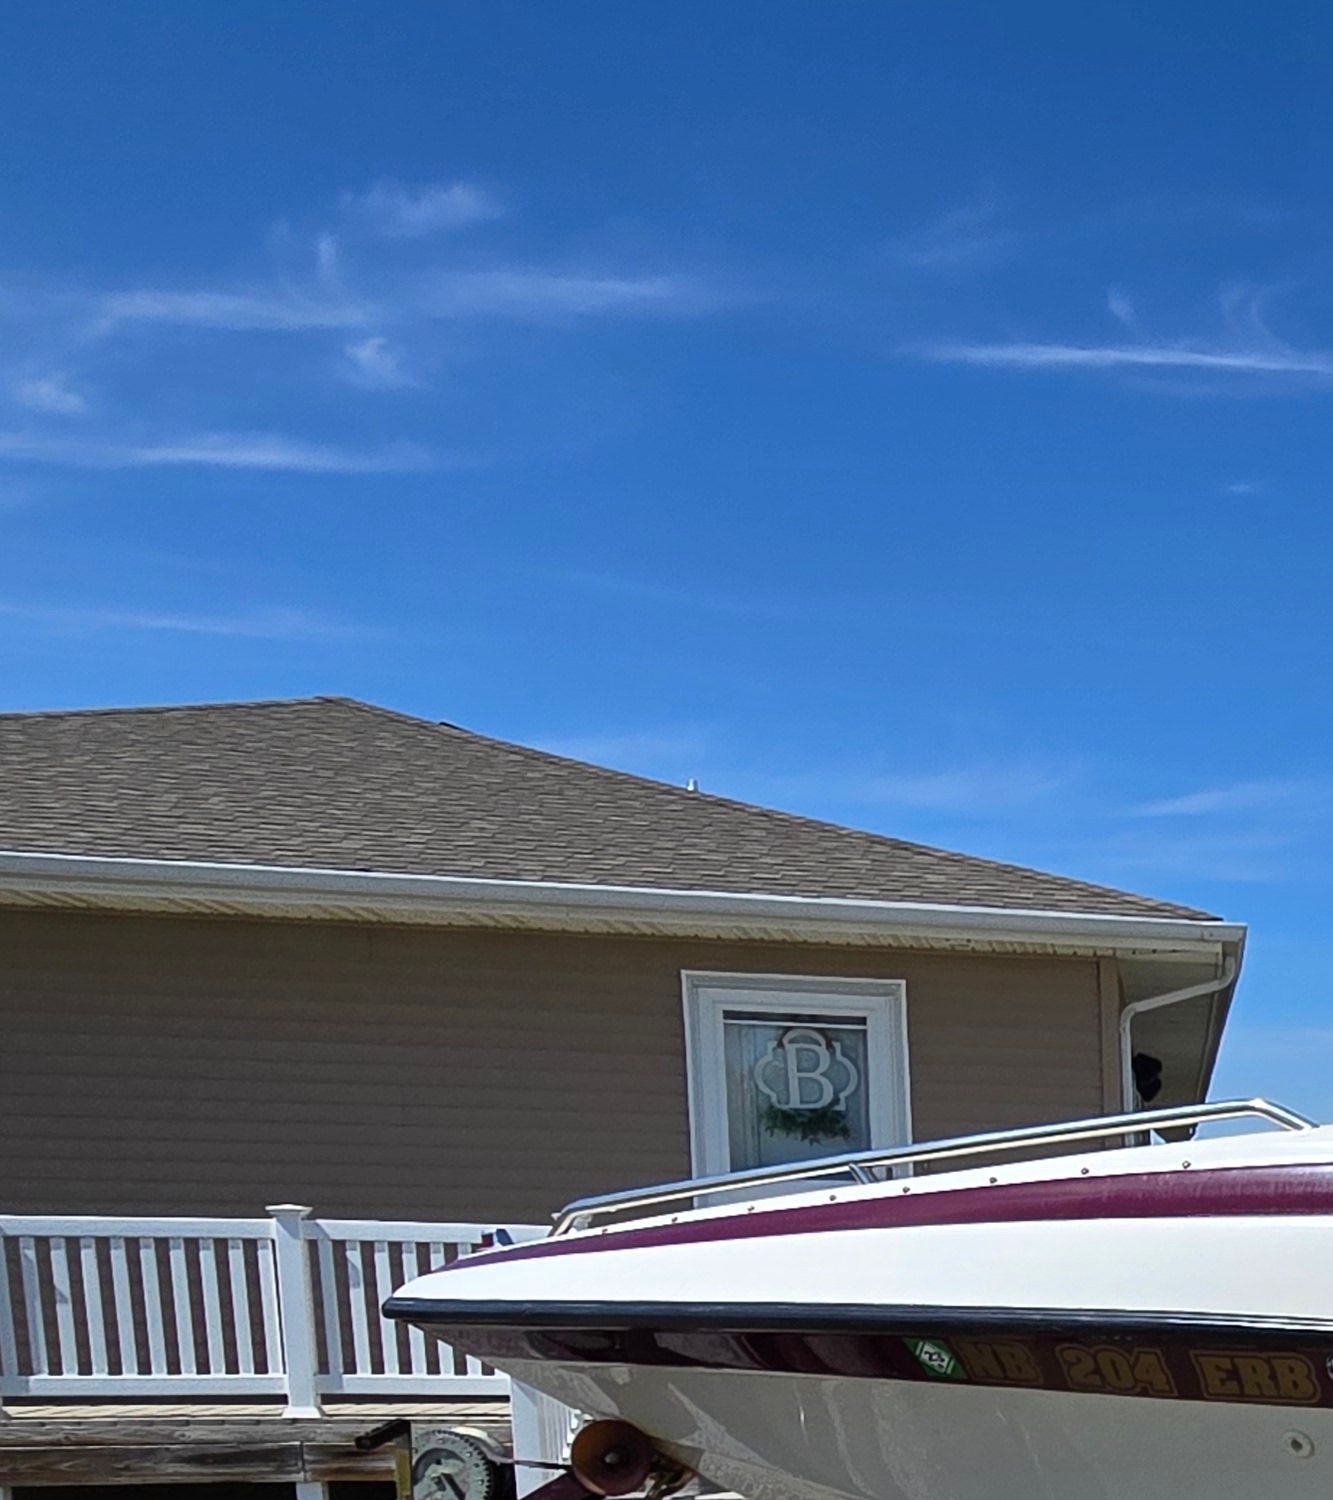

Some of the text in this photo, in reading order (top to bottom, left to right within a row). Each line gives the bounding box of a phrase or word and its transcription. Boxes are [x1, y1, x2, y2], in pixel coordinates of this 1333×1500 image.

[785, 1043, 835, 1110] B
[961, 1339, 1038, 1382] NB
[1064, 1346, 1172, 1394] 204
[1198, 1354, 1316, 1400] ERB
